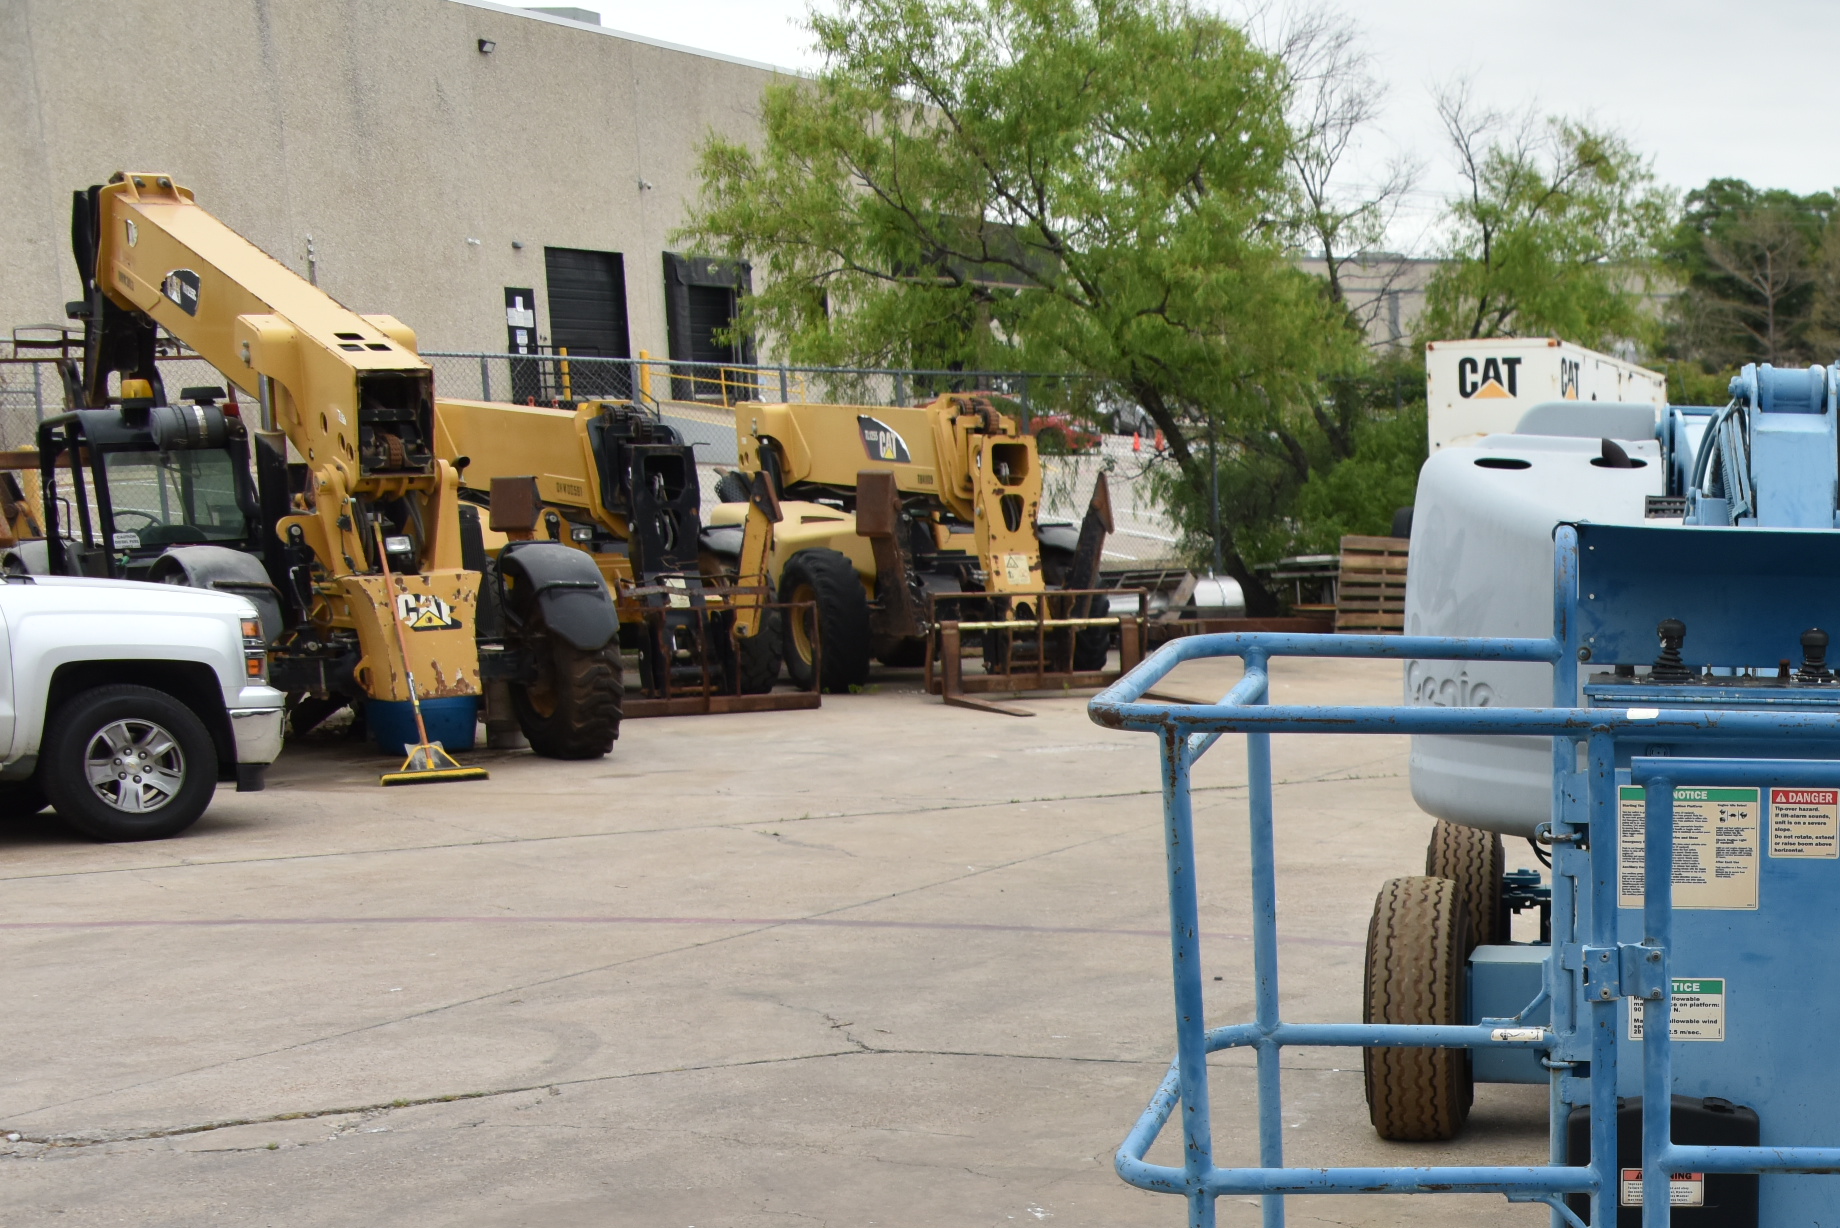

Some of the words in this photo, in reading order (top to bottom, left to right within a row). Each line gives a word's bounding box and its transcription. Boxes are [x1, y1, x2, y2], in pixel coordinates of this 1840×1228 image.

[1459, 357, 1522, 399] CAT
[1561, 357, 1580, 400] CAT
[880, 431, 897, 459] CAT
[1789, 792, 1833, 803] DANGER
[1672, 983, 1700, 992] TICE
